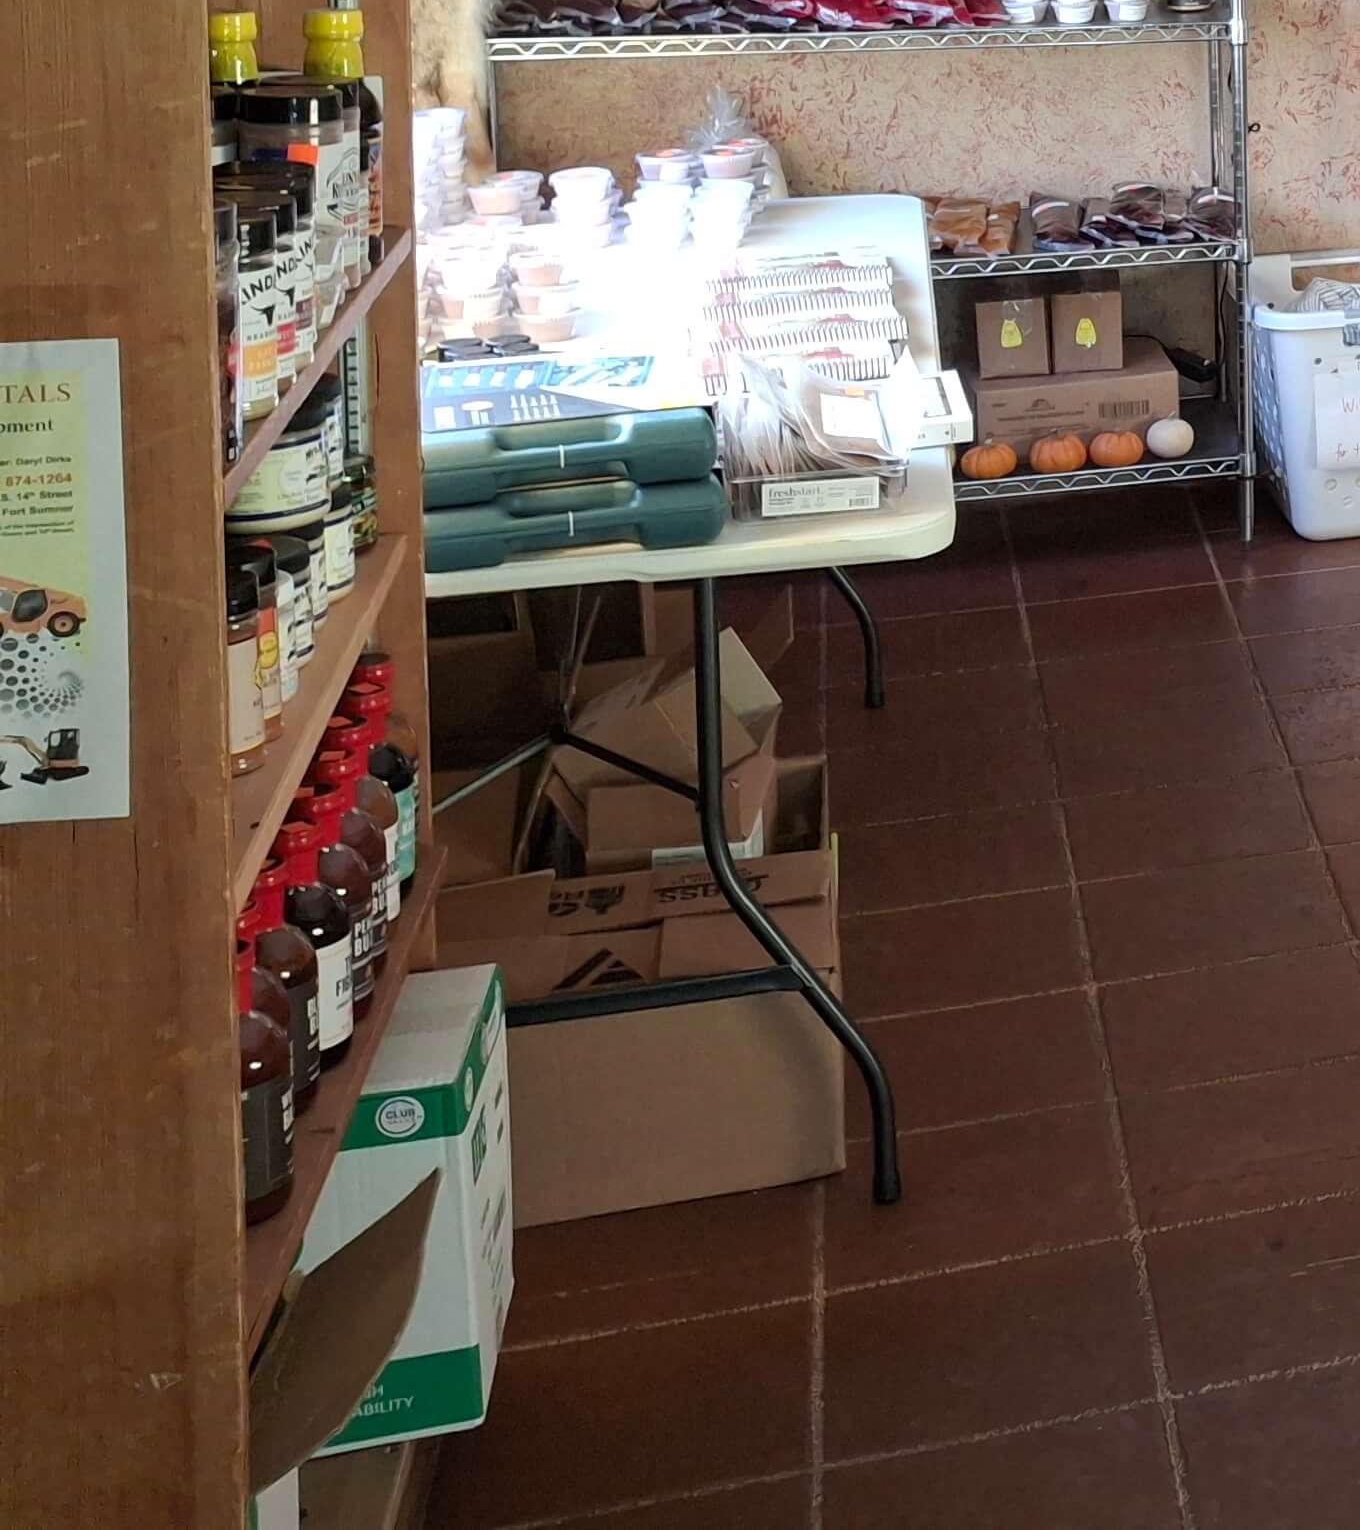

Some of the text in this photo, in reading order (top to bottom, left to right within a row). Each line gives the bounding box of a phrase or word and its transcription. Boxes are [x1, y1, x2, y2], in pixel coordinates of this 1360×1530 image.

[39, 490, 73, 500] Street
[2, 505, 73, 517] Fort Sumner
[385, 1108, 417, 1121] CLUB
